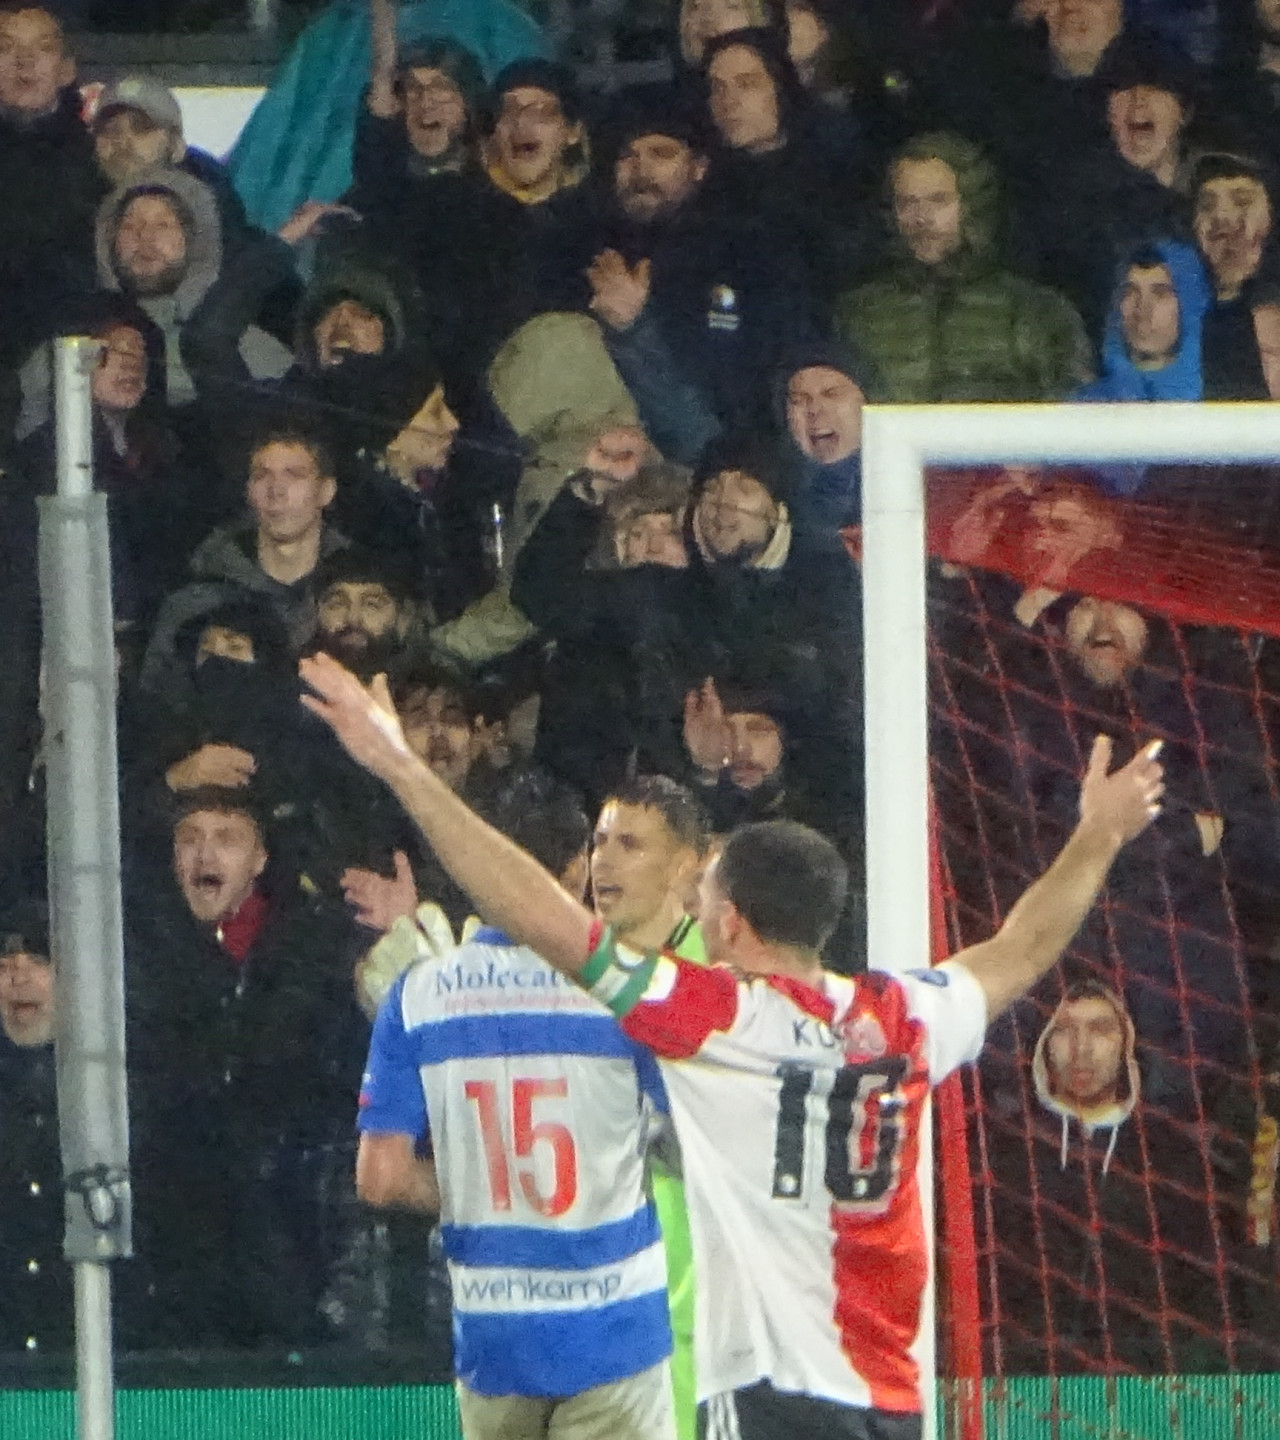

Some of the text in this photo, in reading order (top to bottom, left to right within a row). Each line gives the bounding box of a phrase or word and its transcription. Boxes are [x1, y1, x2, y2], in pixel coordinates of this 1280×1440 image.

[464, 1077, 576, 1217] 15
[772, 1056, 908, 1200] 10
[461, 1271, 622, 1302] wehkamp
